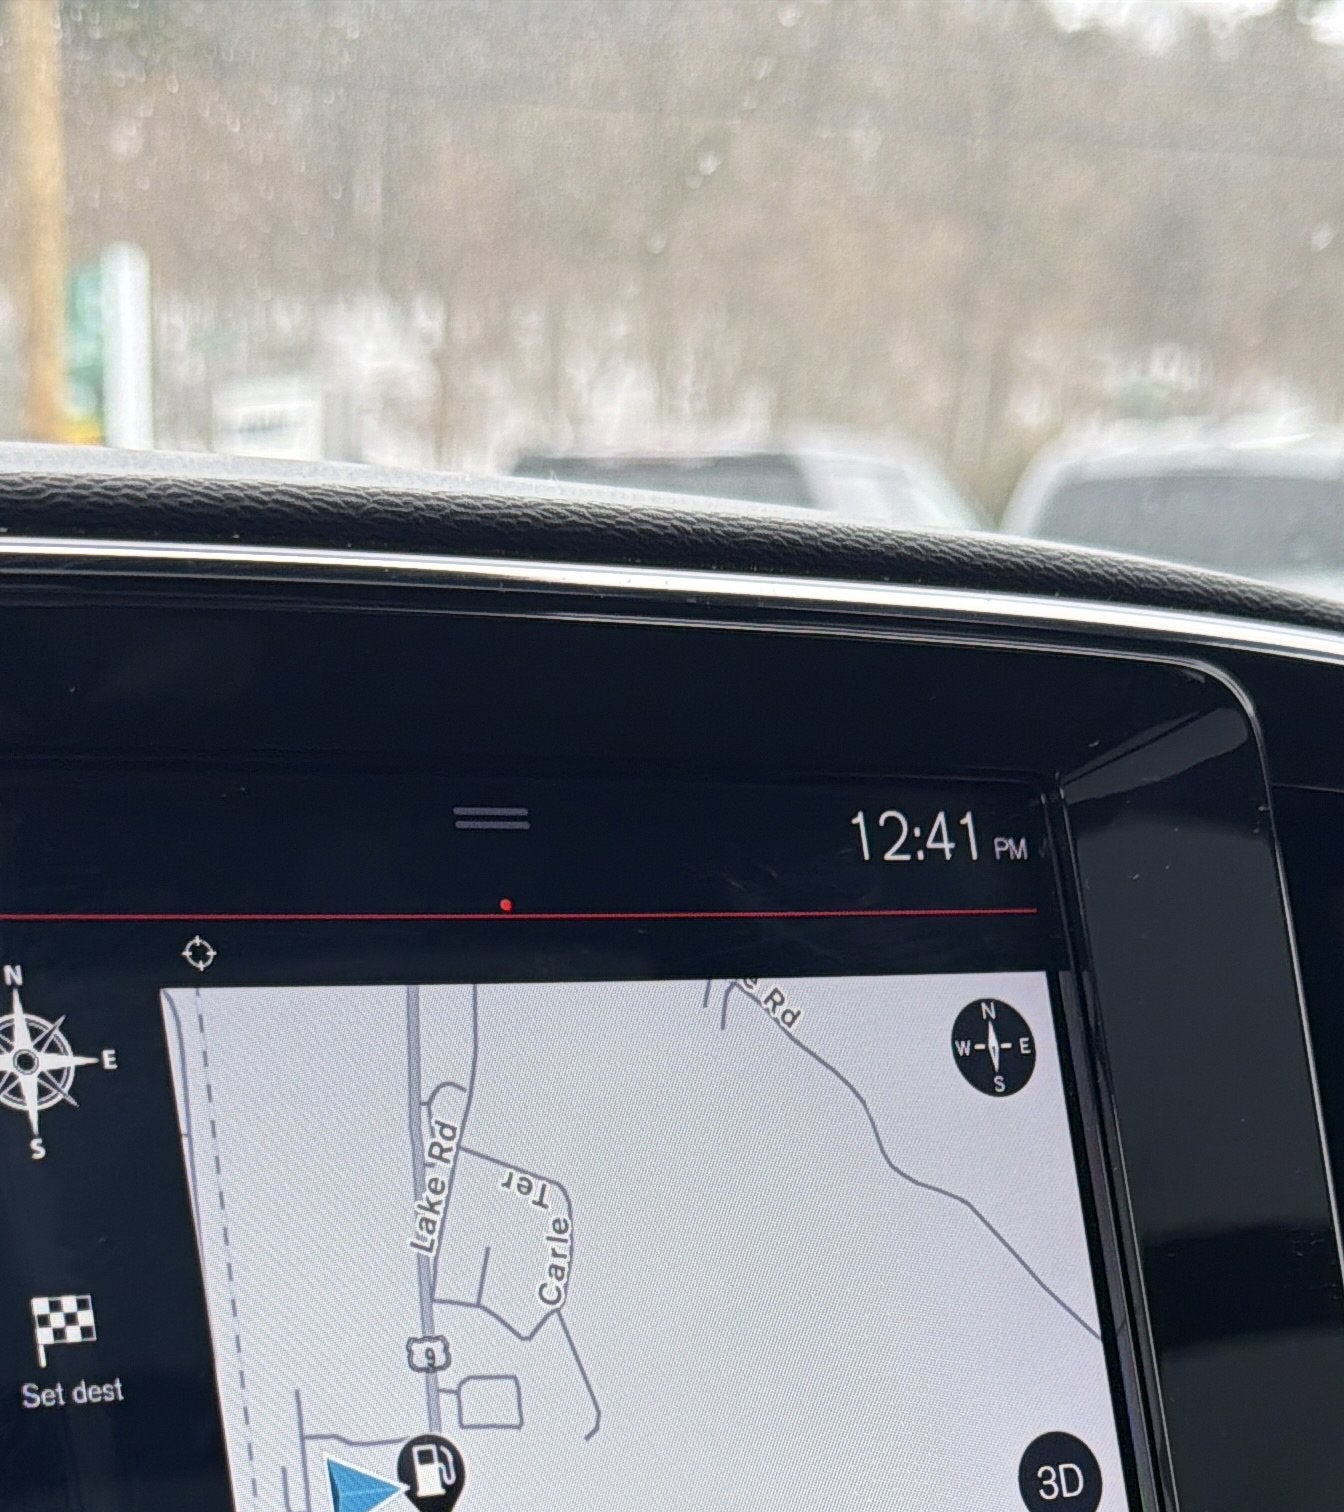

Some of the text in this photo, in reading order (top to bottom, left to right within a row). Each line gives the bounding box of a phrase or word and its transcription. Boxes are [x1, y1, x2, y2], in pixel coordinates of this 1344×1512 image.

[851, 810, 1028, 861] 12:41 PM
[3, 964, 23, 986] N
[763, 987, 801, 1029] Rd
[980, 1001, 997, 1020] N
[955, 1039, 971, 1057] W
[1018, 1037, 1032, 1055] E
[102, 1049, 118, 1070] E
[993, 1075, 1007, 1093] S
[30, 1138, 47, 1161] S
[409, 1119, 457, 1254] Lake Rd
[500, 1171, 569, 1306] Carle Ter
[22, 1378, 124, 1409] Set dest
[1036, 1463, 1085, 1500] 3D
